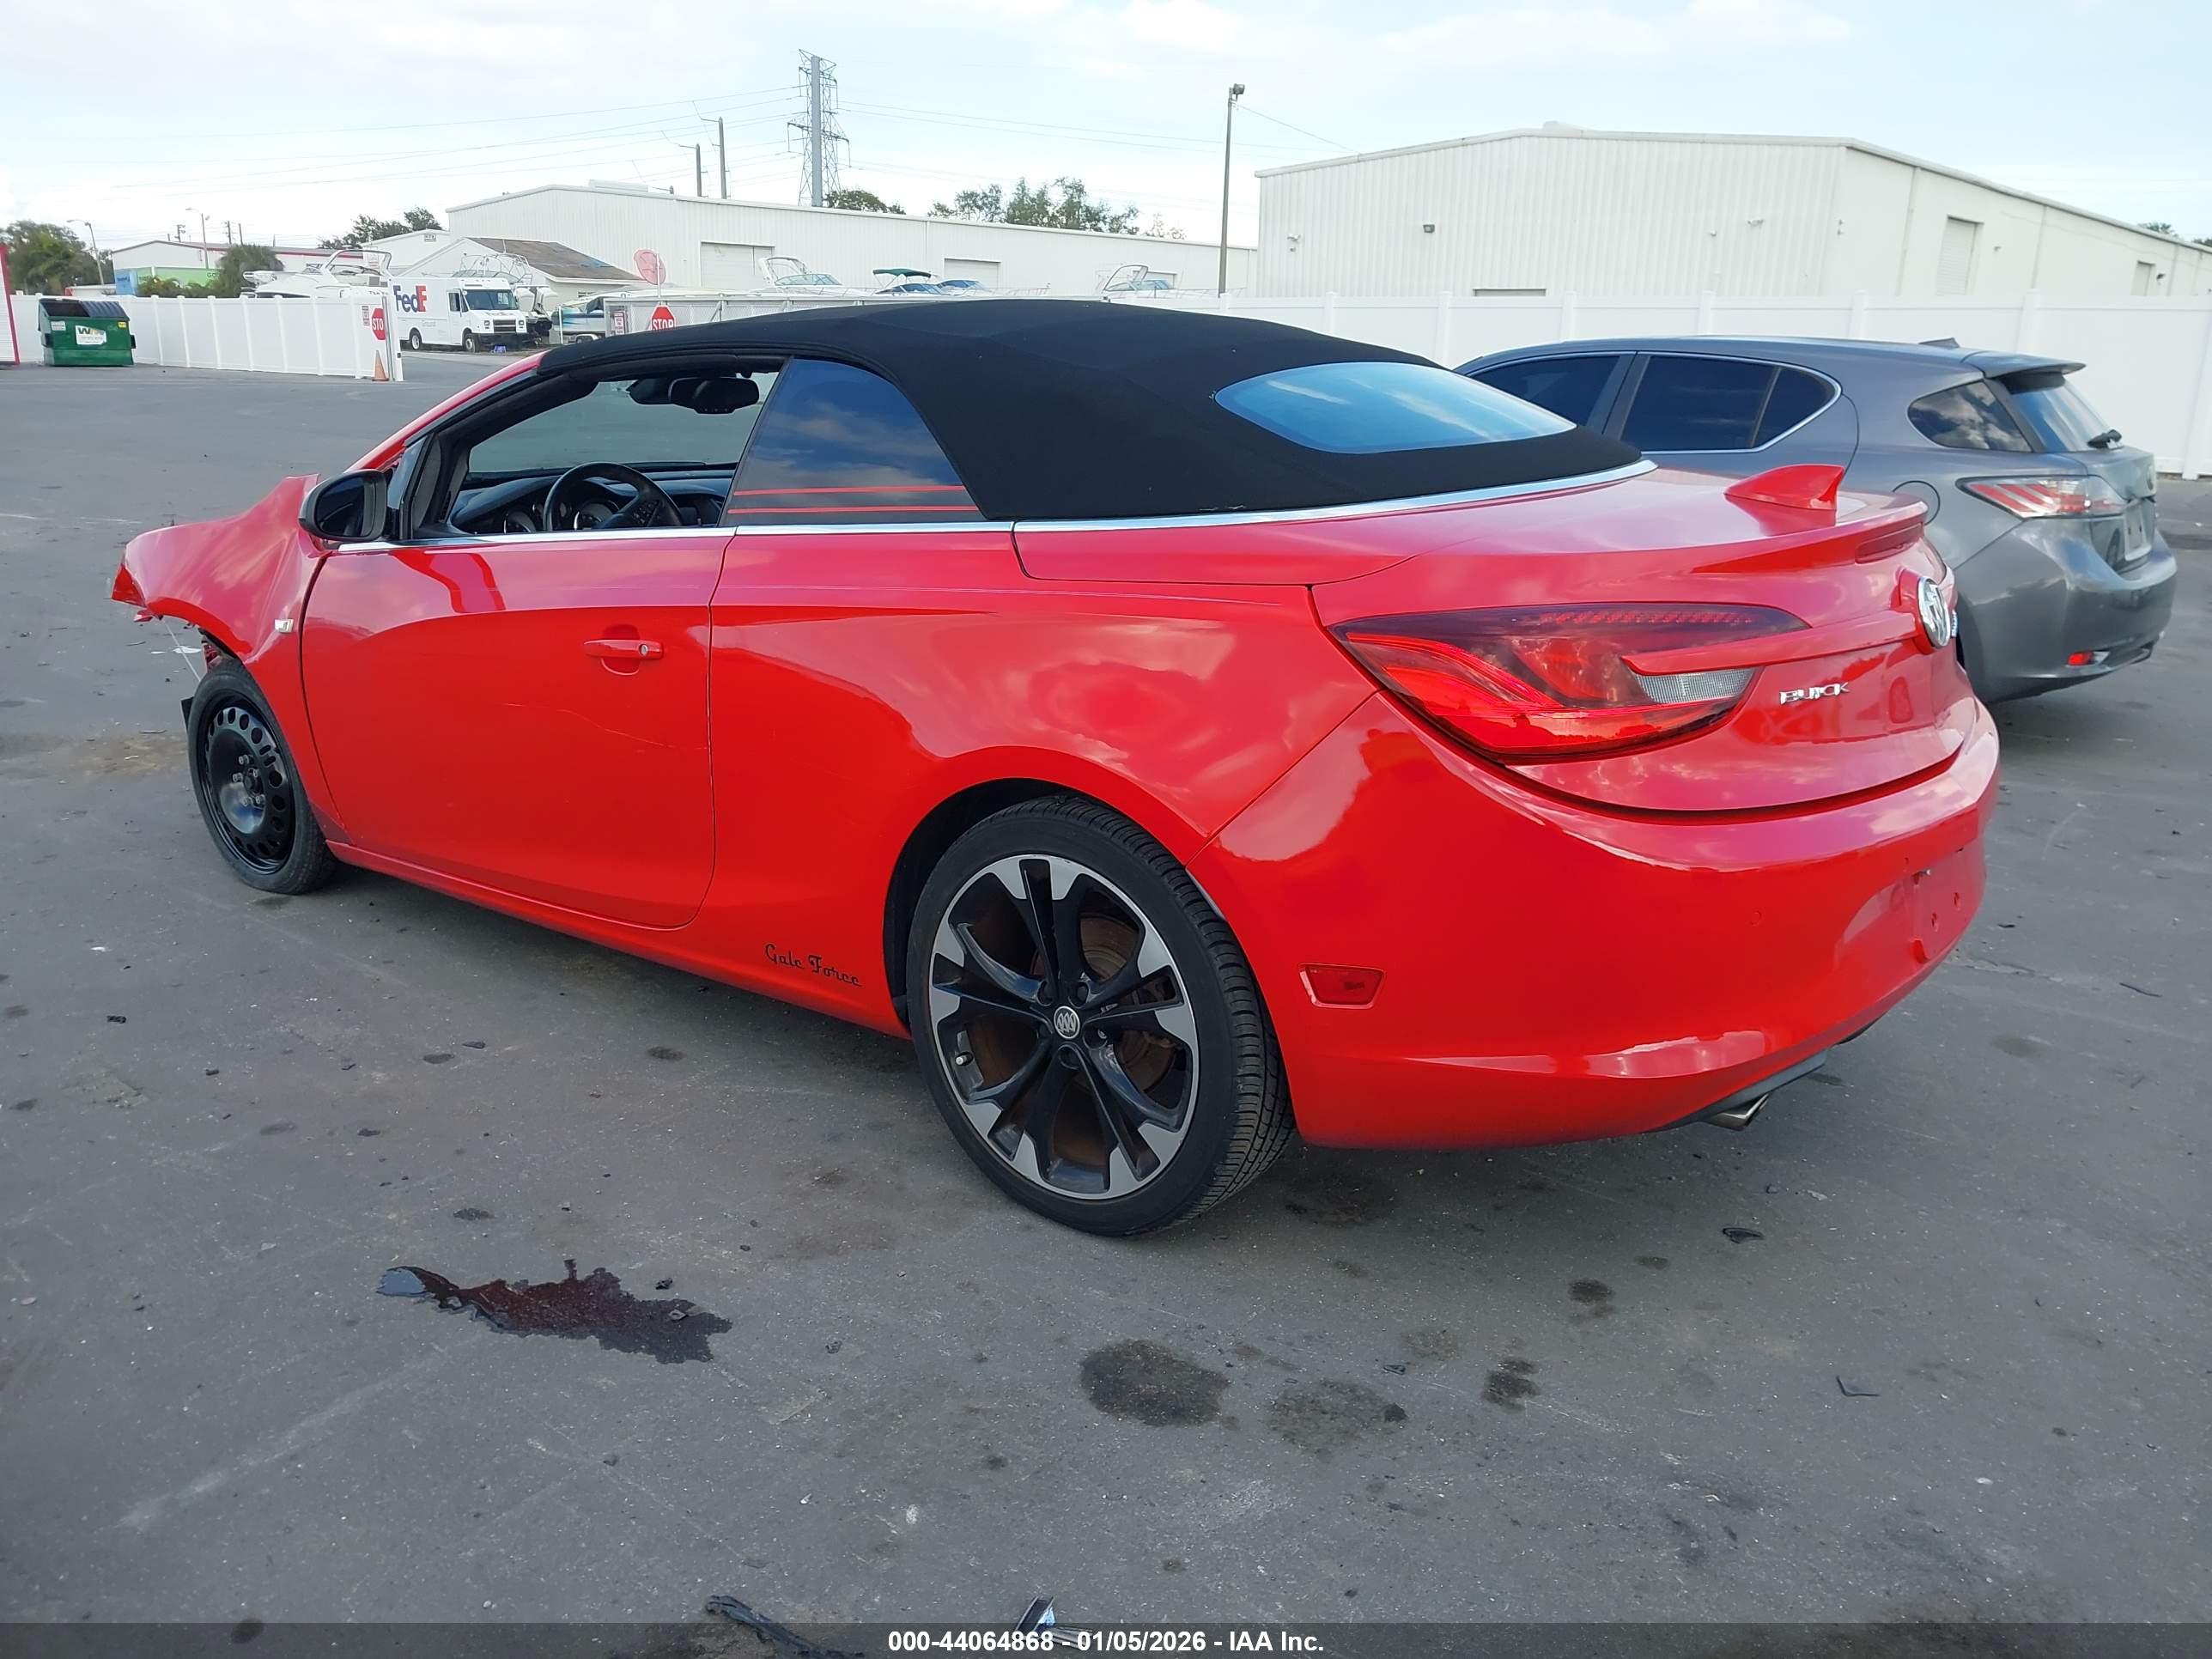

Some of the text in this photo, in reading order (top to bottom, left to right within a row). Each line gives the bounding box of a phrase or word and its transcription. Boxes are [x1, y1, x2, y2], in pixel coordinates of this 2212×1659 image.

[653, 319, 673, 330] STOP
[1779, 682, 1850, 705] BUICK
[765, 943, 862, 988] Gale Force
